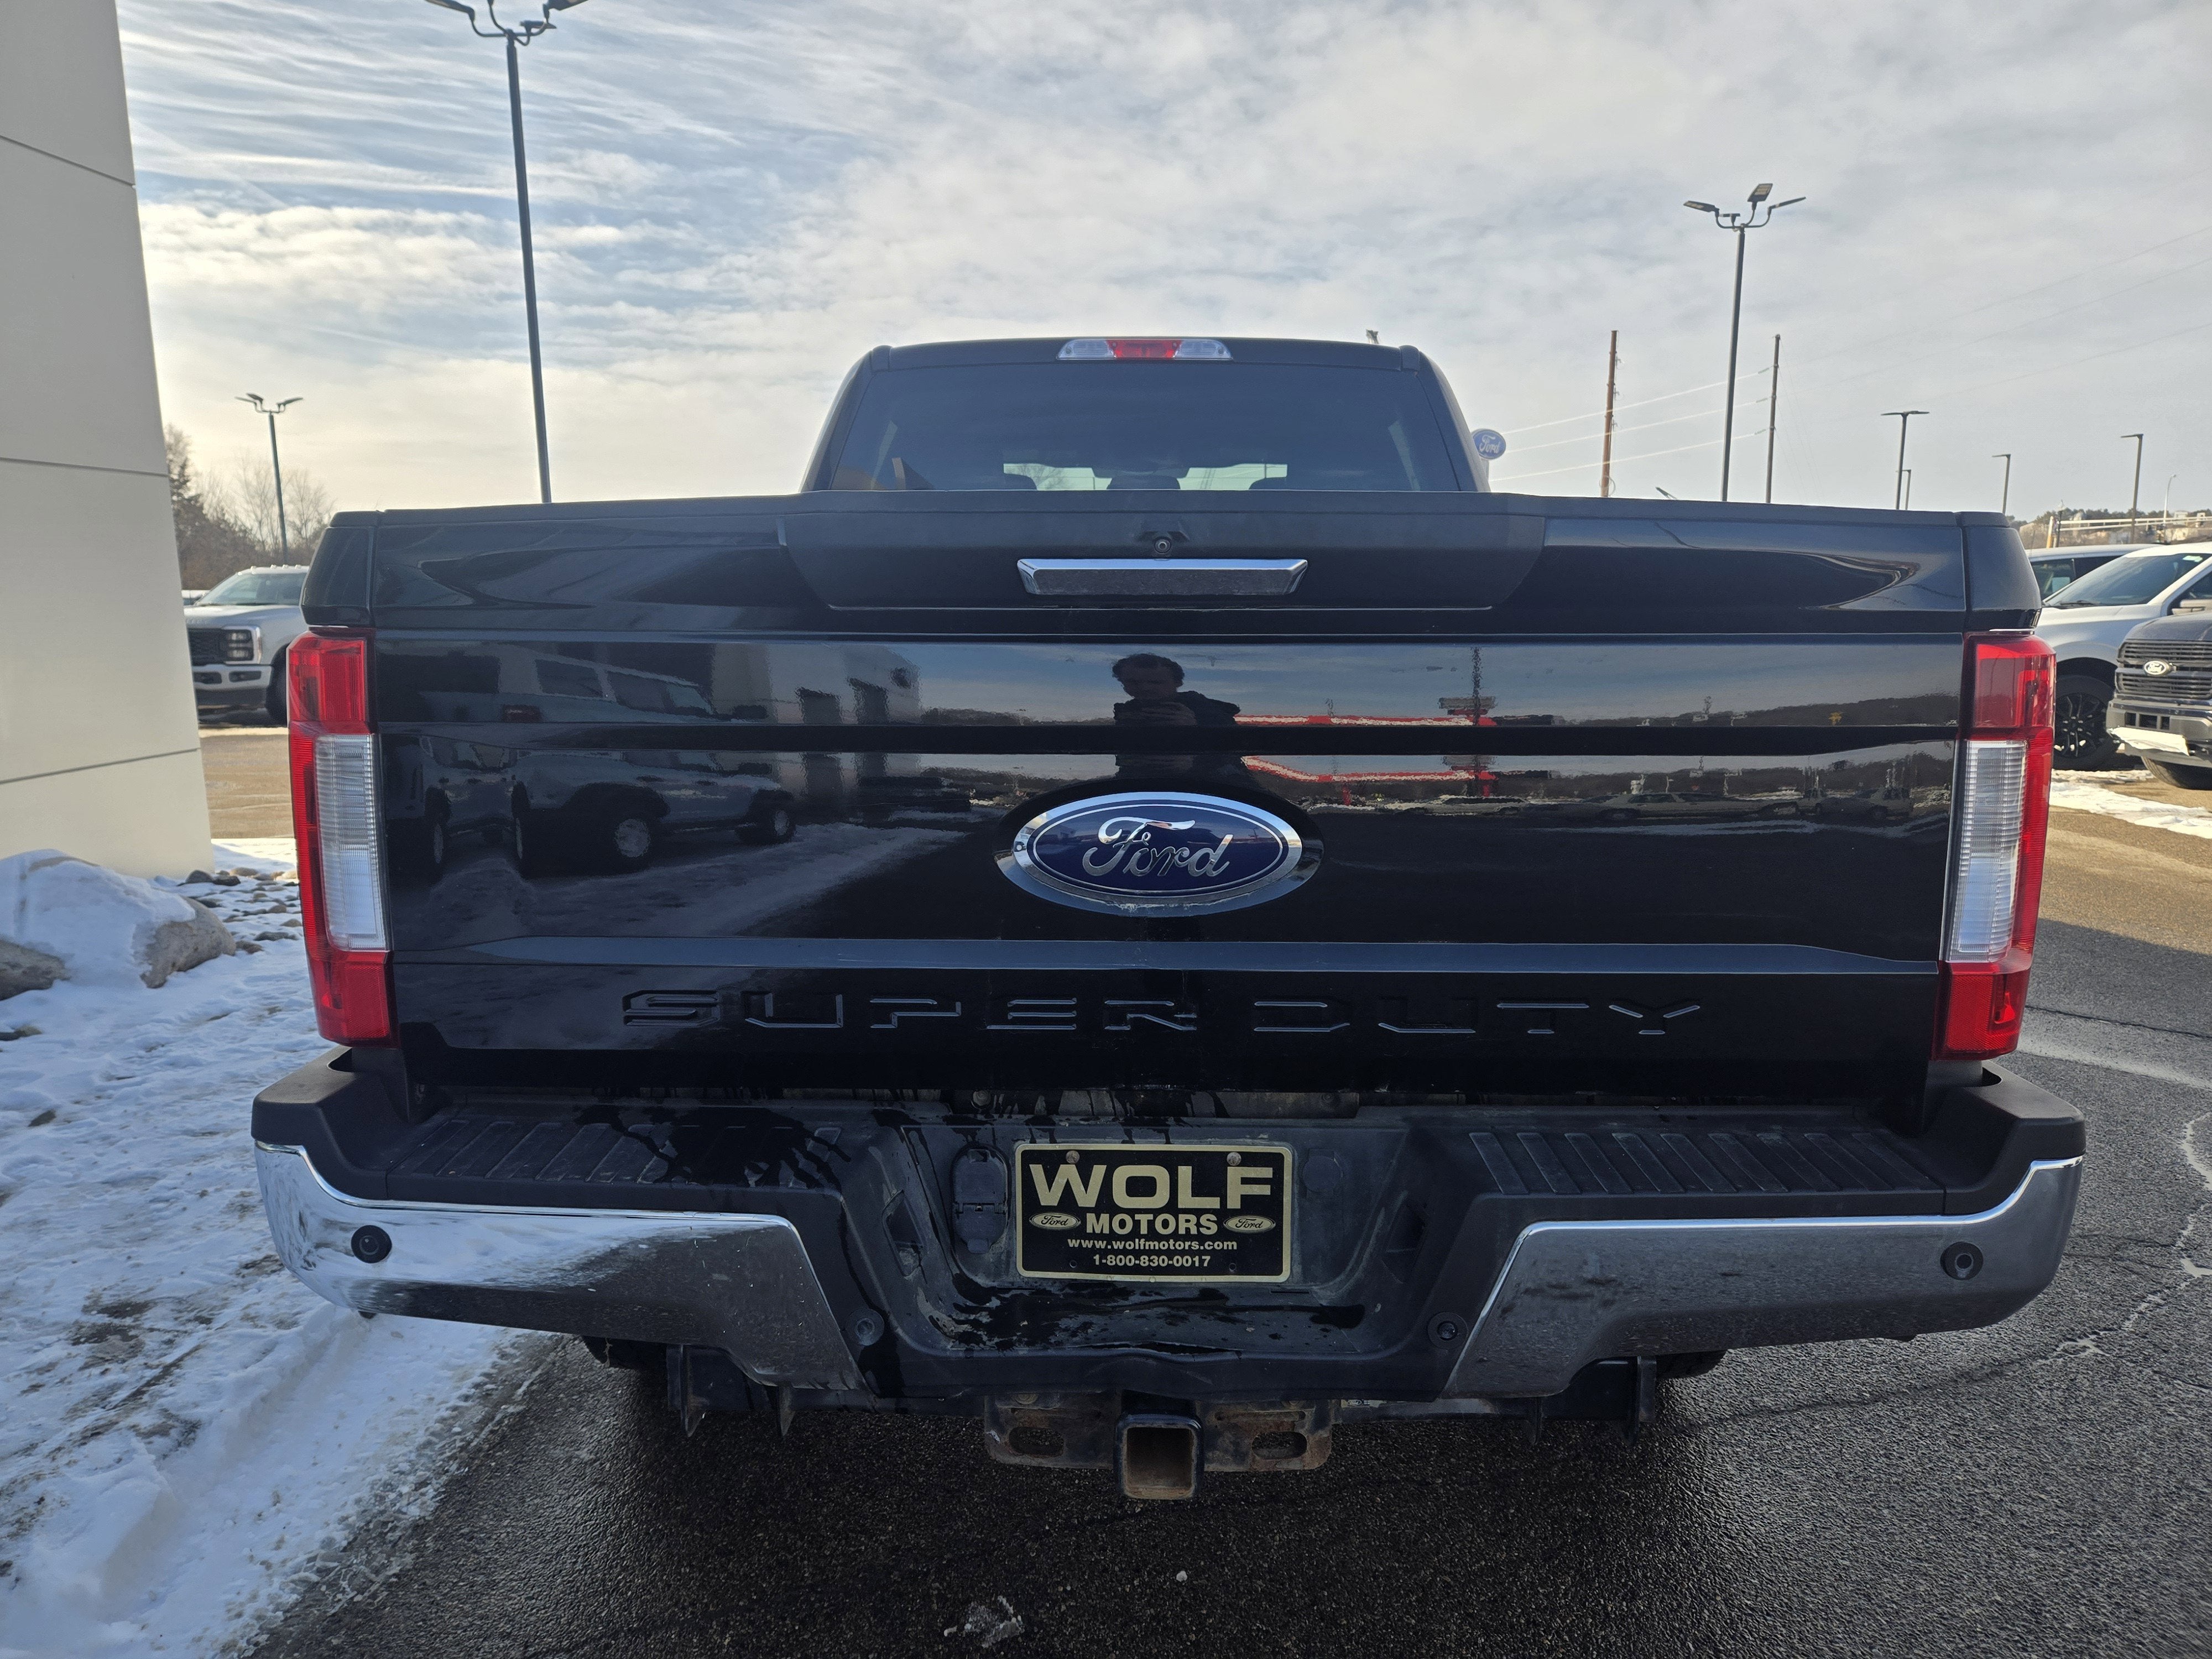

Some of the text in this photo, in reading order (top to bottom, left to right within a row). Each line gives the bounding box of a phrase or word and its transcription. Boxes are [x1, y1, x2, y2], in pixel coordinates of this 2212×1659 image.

[1479, 434, 1501, 454] Ford
[1082, 816, 1234, 878] Ford
[622, 989, 1702, 1036] SUPER DUTY
[1029, 1164, 1273, 1209] WOLF
[1040, 1215, 1069, 1227] Ford
[1086, 1213, 1218, 1235] MOTORS
[1234, 1218, 1264, 1230] Ford
[1067, 1238, 1238, 1251] www.wolfmotors.com
[1093, 1254, 1211, 1267] 1-800-830-0017
